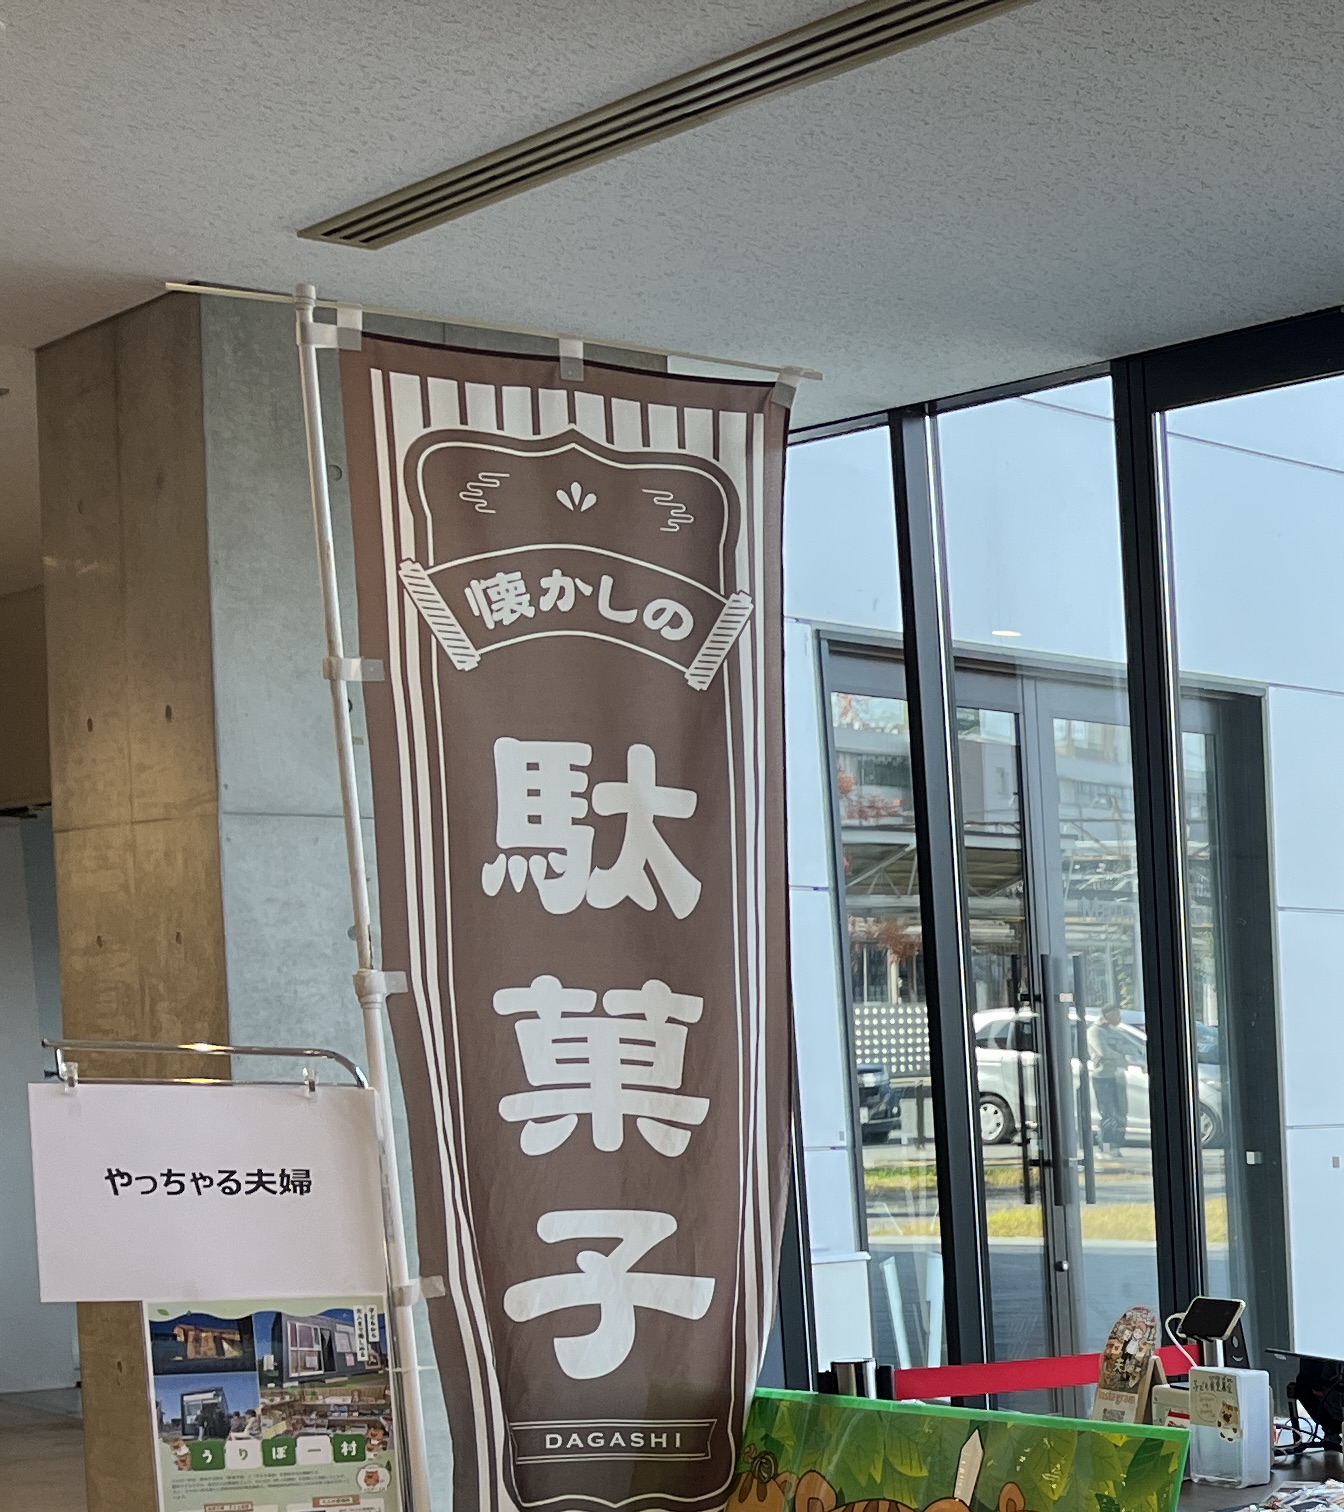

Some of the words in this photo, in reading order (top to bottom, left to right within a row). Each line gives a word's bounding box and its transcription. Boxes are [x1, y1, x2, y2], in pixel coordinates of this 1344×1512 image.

[464, 569, 697, 642] 懐かしの
[481, 736, 717, 1381] 駄菓子
[104, 1167, 313, 1198] やっちゃる夫婦
[545, 1430, 684, 1451] DAGASHI
